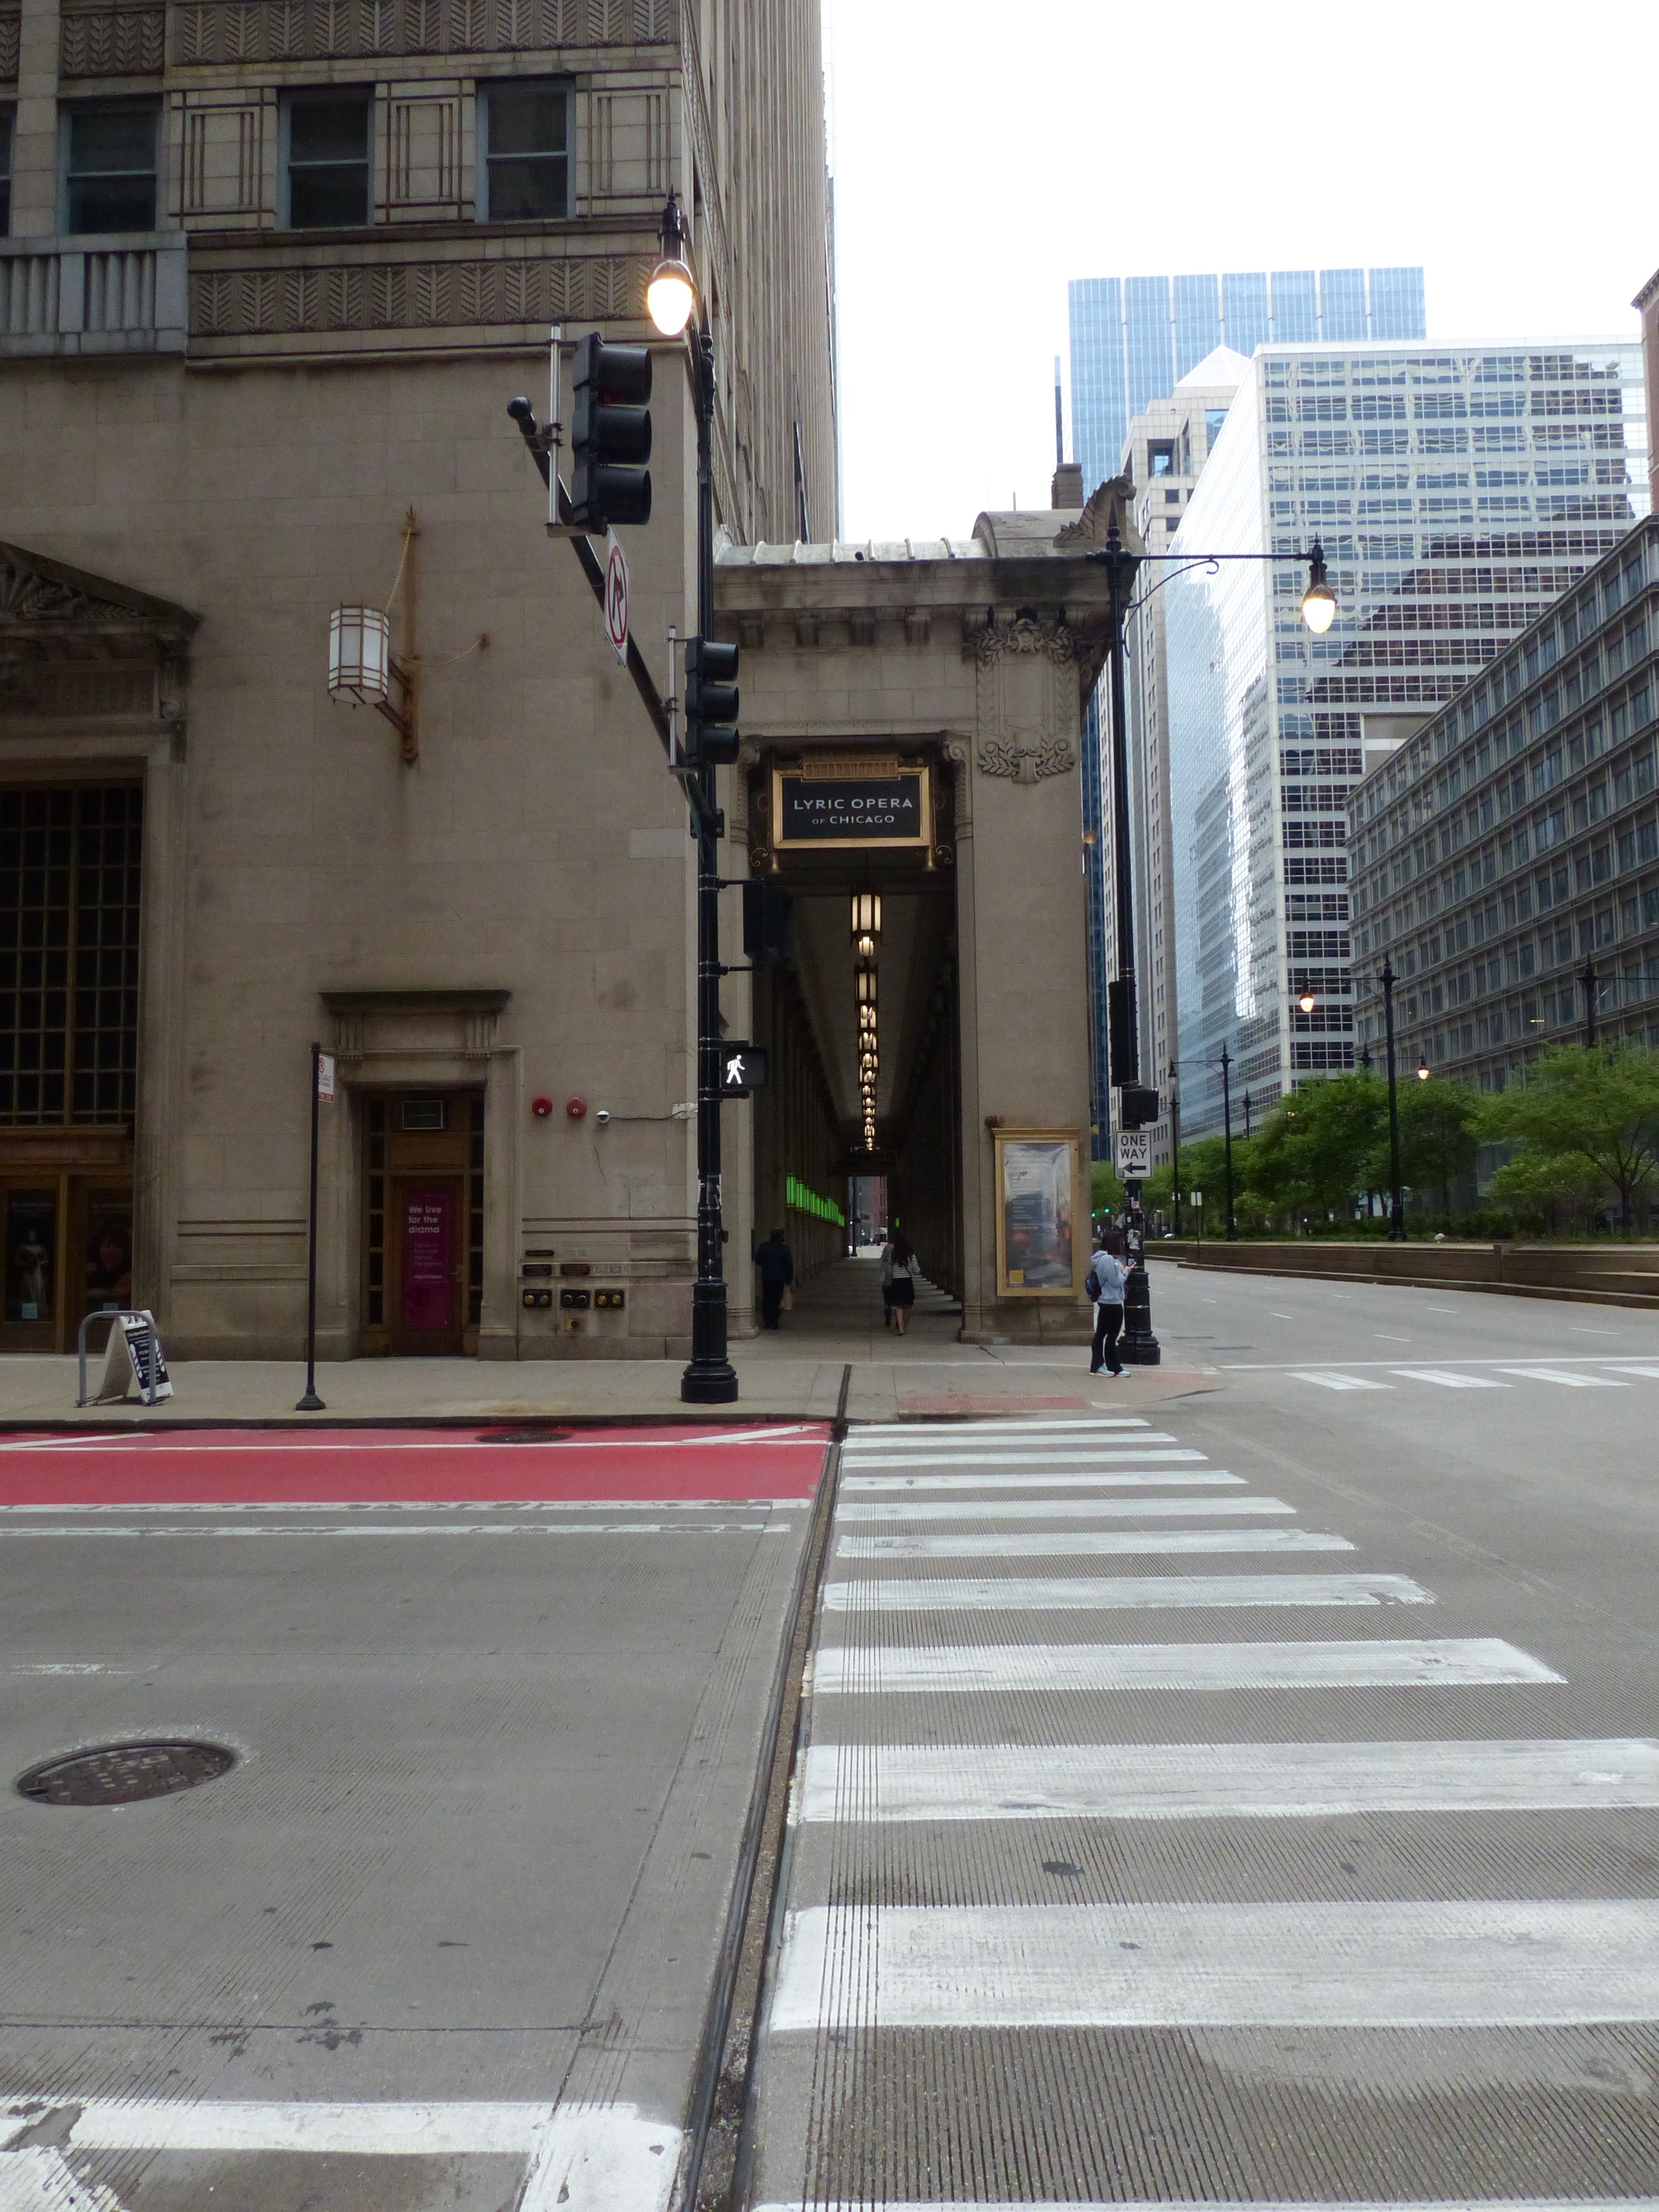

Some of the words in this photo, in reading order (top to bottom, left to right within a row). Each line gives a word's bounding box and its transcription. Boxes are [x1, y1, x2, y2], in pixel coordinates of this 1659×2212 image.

[794, 799, 845, 810] LYRIC
[851, 797, 913, 808] OPERA
[830, 815, 895, 824] CHICAGO
[1120, 1135, 1147, 1146] ONE
[1120, 1148, 1147, 1159] WAY
[408, 1215, 421, 1224] for
[408, 1225, 440, 1234] drama
